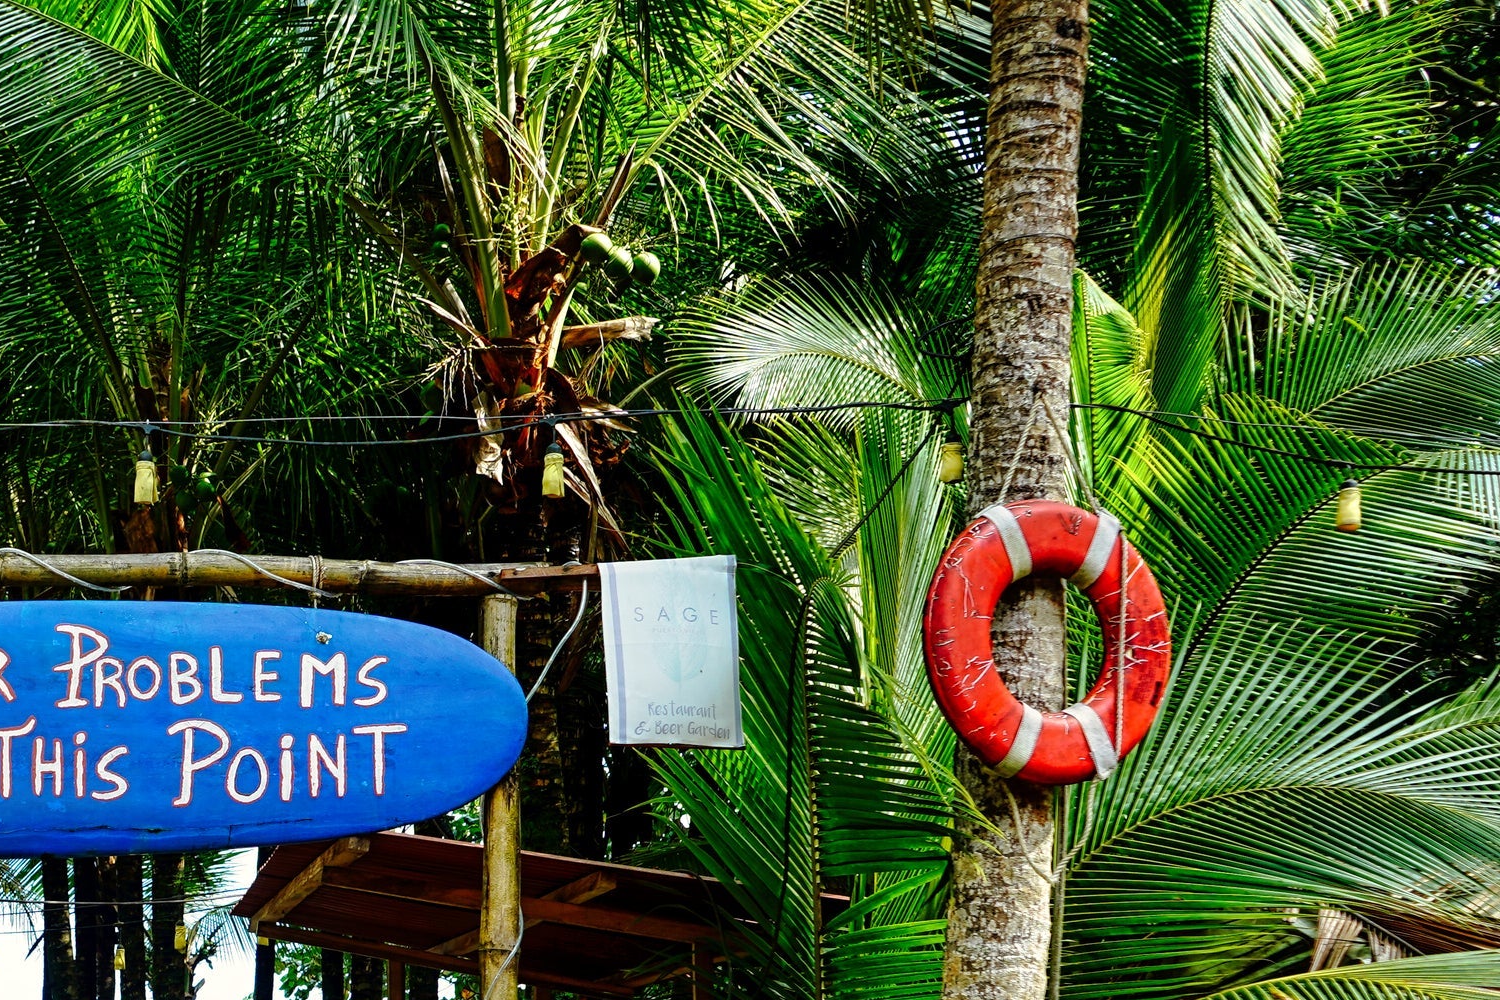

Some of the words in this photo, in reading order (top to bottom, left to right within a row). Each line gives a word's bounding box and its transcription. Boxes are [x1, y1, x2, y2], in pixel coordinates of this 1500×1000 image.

[633, 606, 719, 625] SAGE
[52, 621, 389, 709] PROBLEMS
[647, 700, 717, 720] Restaurant
[655, 720, 683, 735] Beer
[687, 721, 730, 740] Garden
